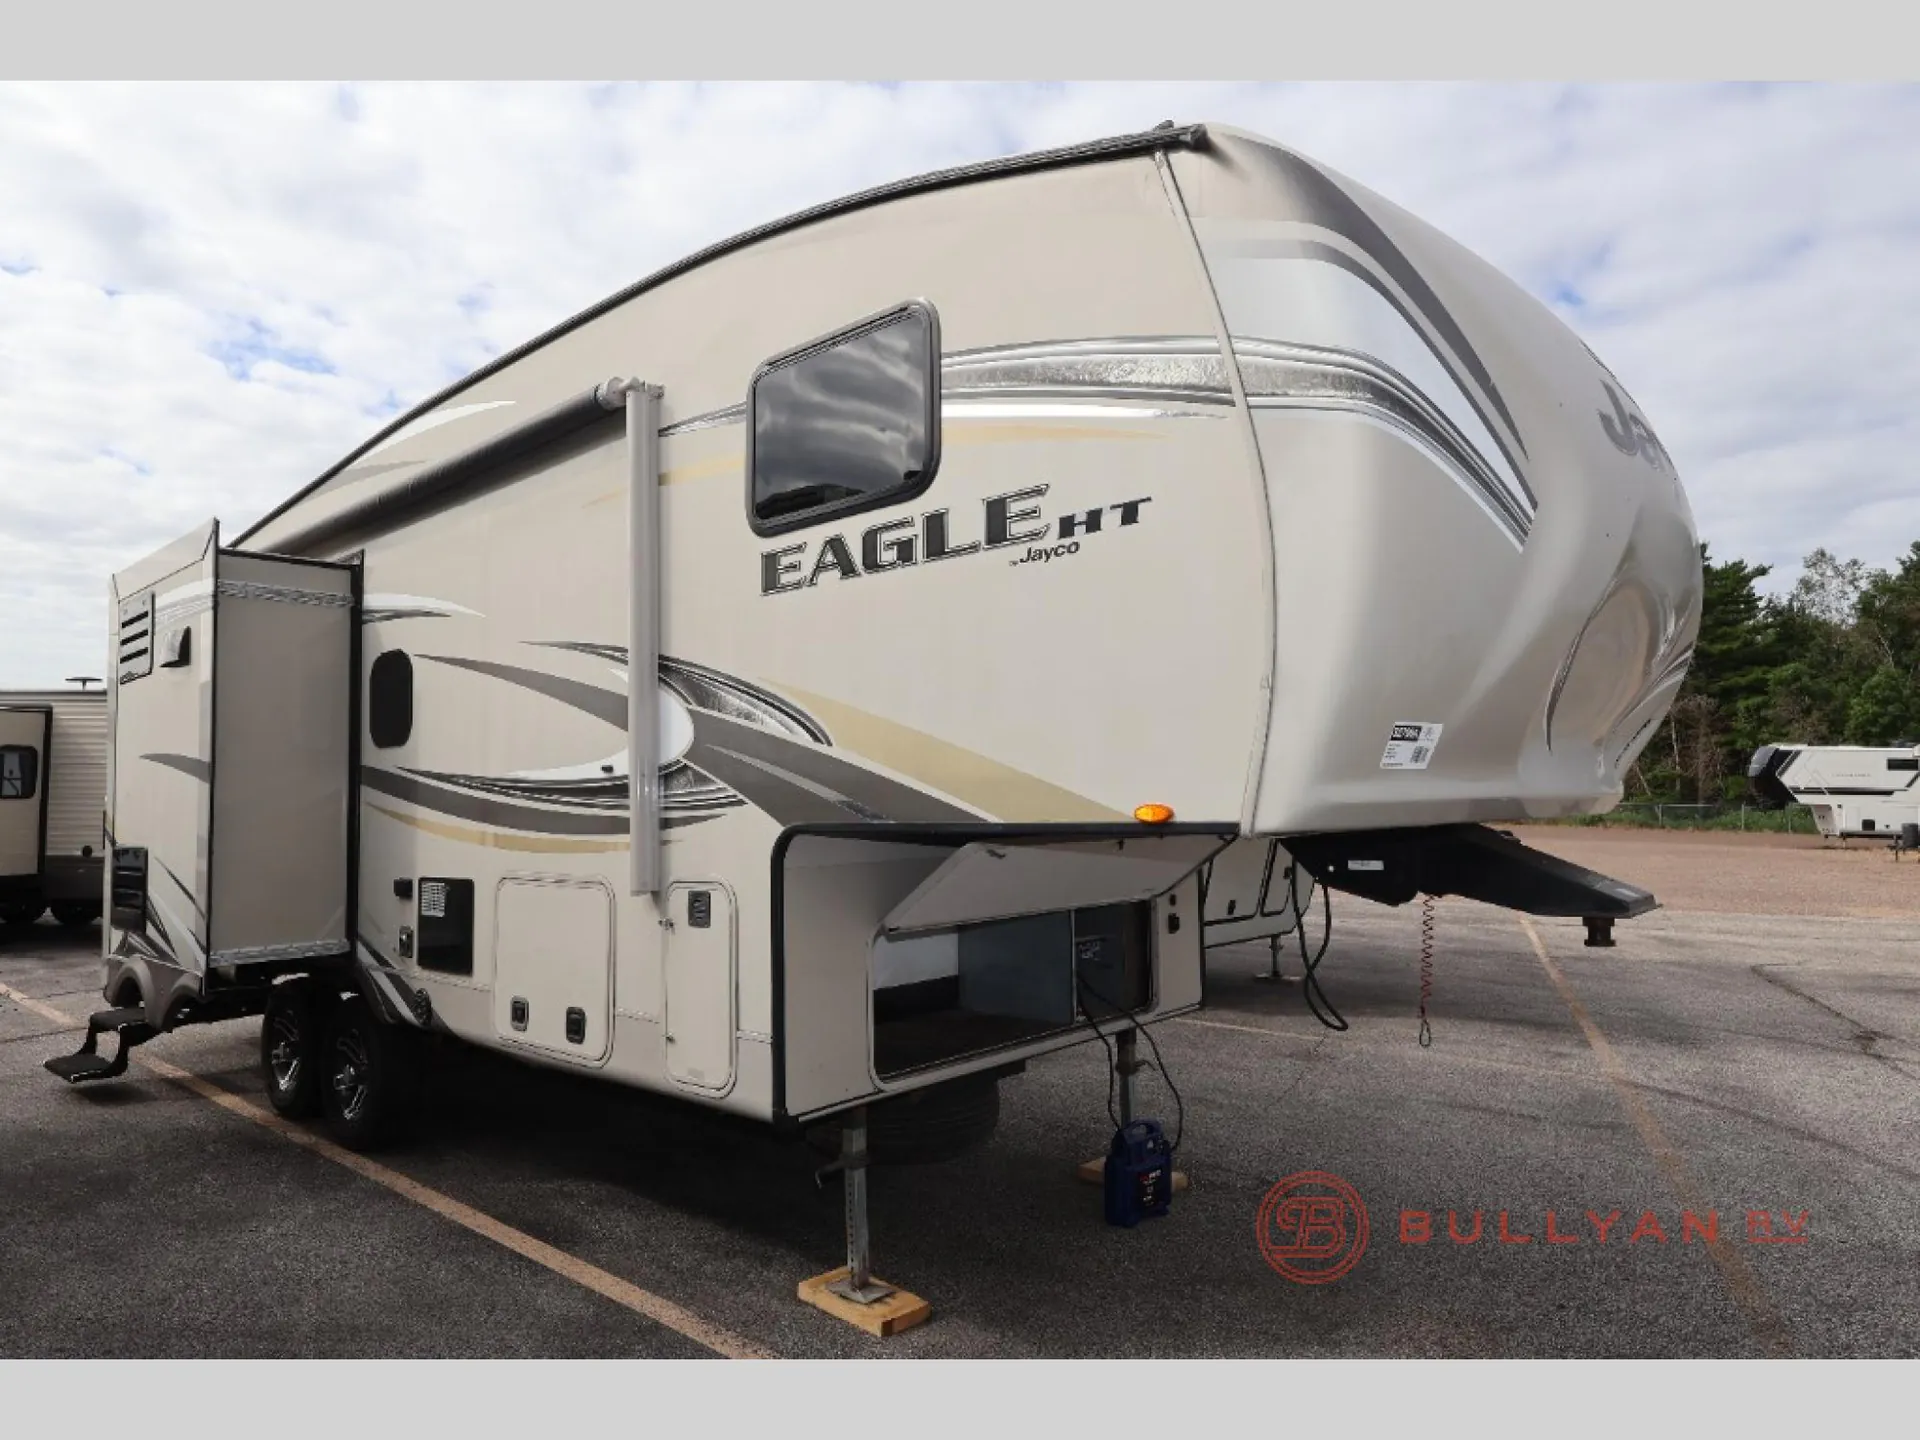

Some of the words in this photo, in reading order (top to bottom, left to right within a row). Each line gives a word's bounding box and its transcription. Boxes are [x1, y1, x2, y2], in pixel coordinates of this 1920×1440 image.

[761, 483, 1051, 597] EAGLE
[1059, 497, 1153, 540] HT
[1019, 541, 1081, 564] Jayco
